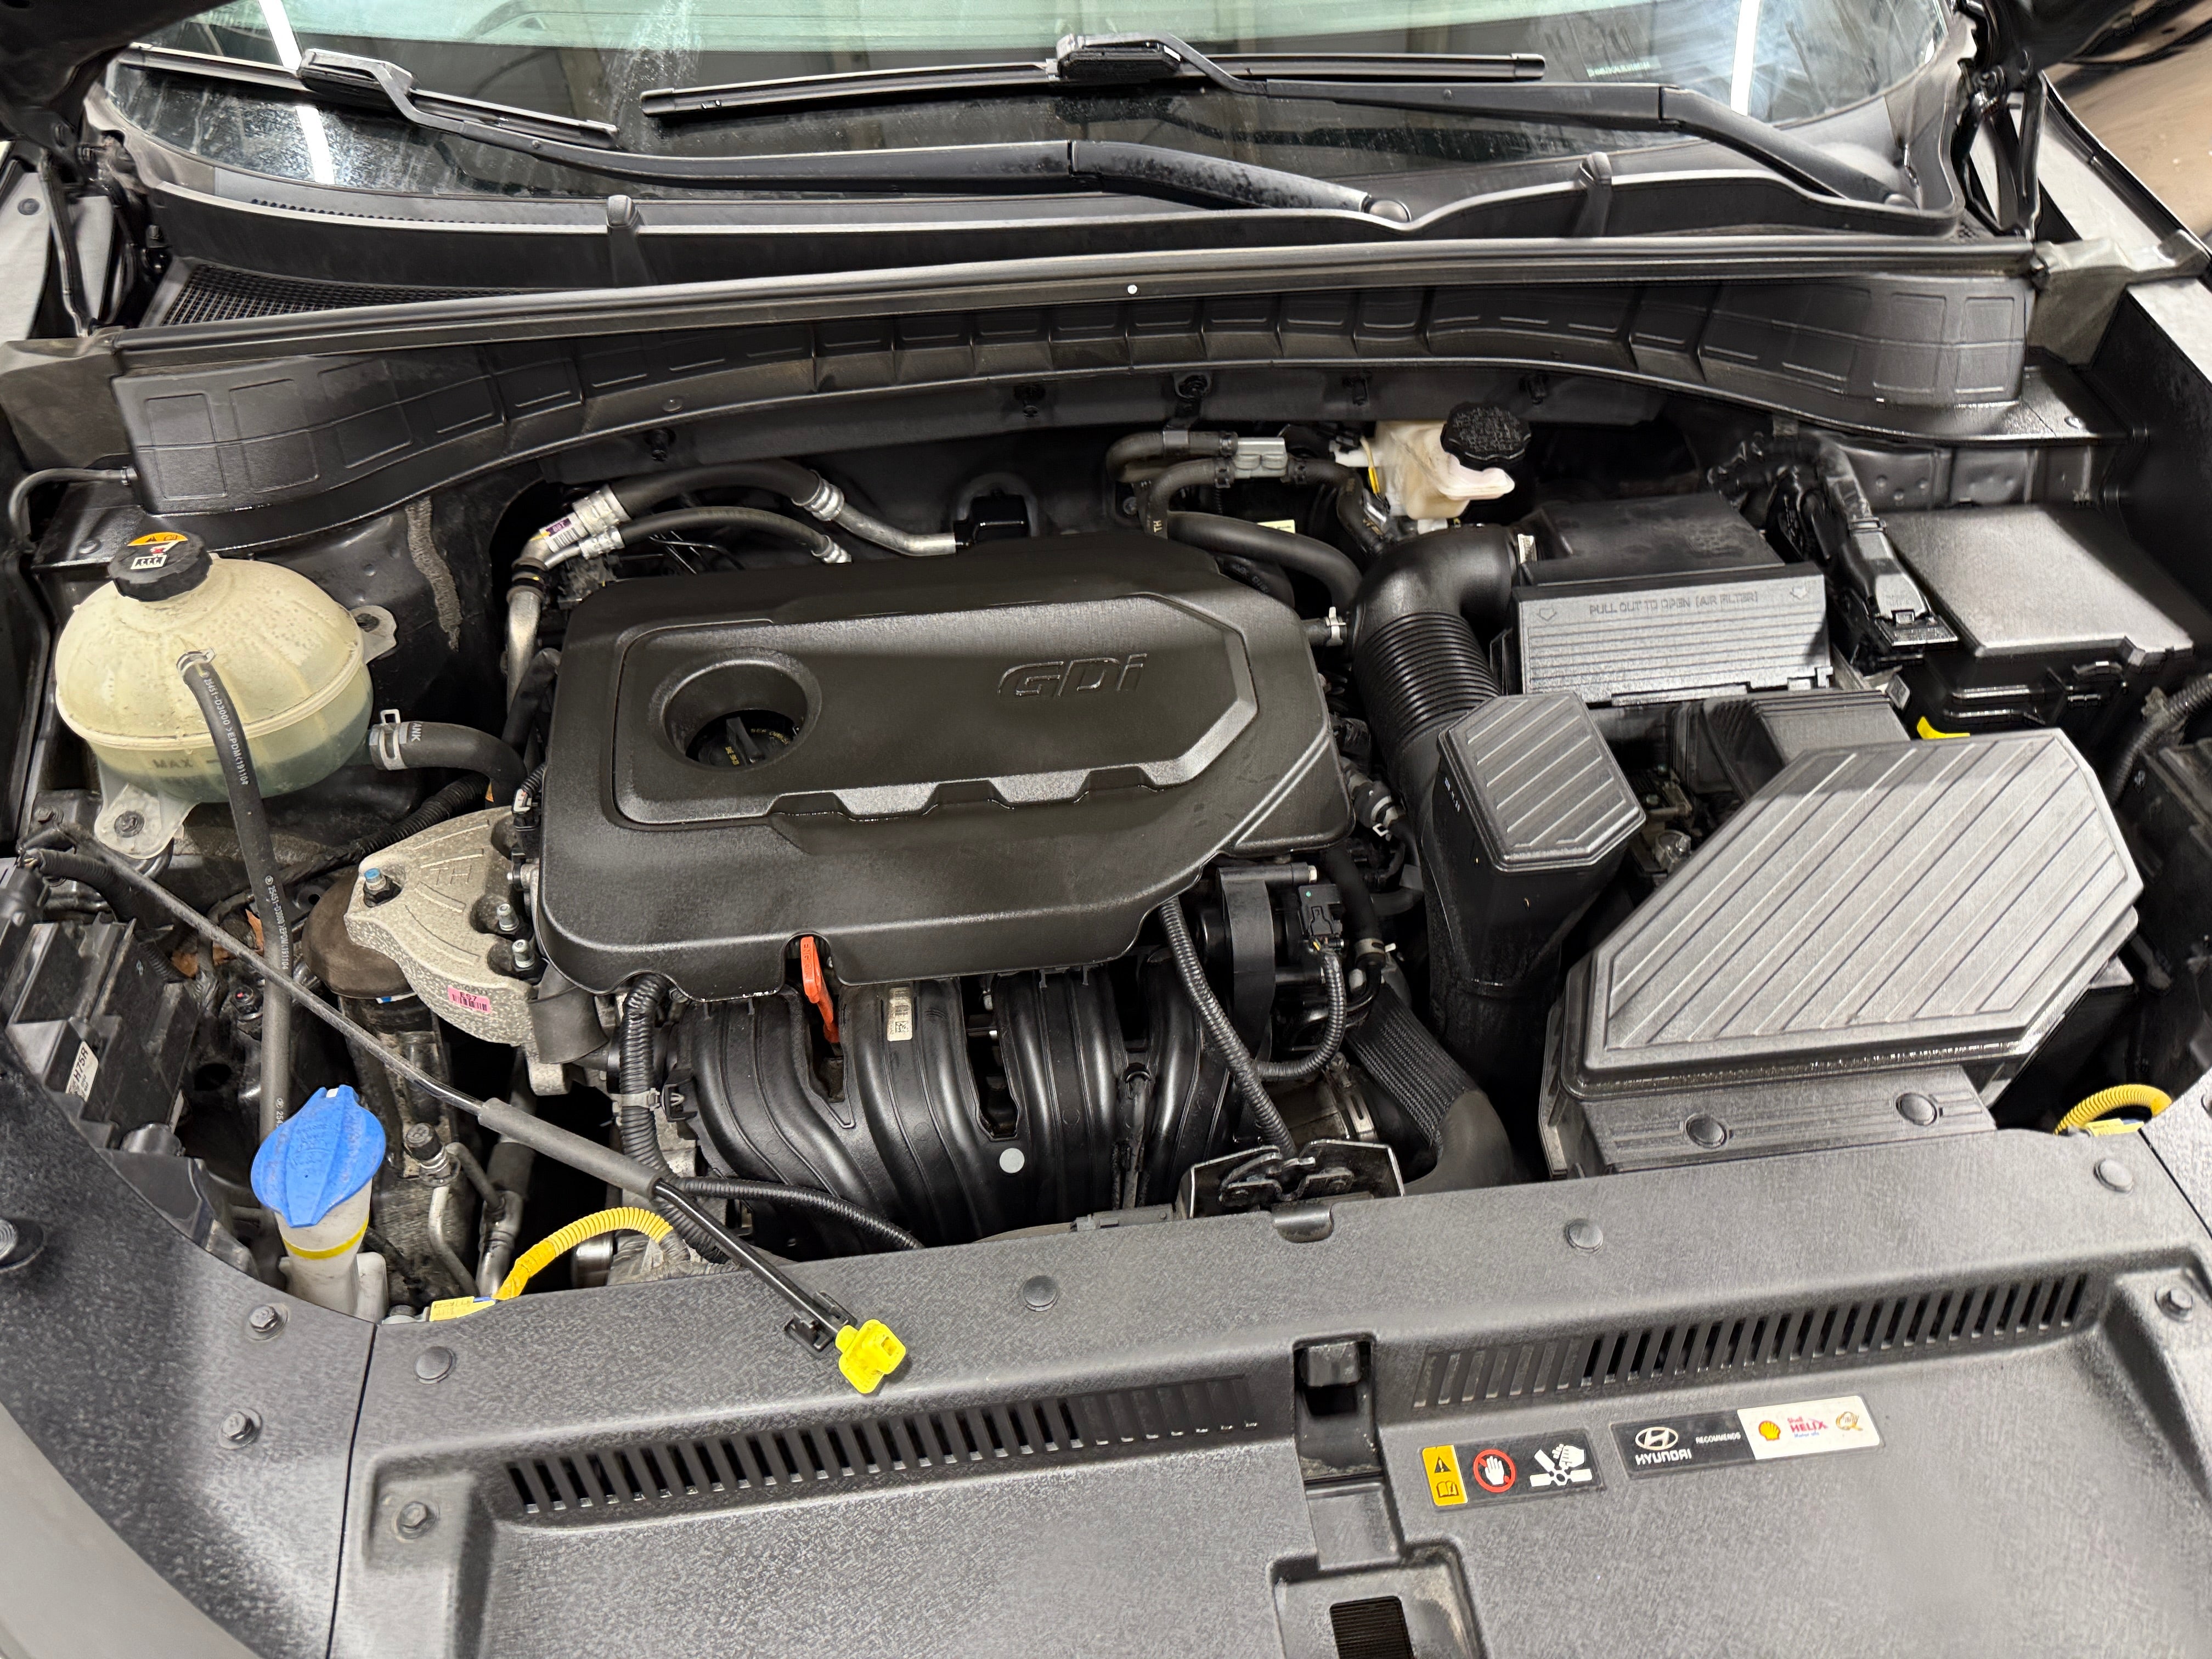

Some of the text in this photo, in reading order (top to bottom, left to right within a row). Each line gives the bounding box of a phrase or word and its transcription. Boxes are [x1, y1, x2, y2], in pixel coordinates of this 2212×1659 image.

[1589, 603, 1617, 615] PULL
[1620, 600, 1642, 612] OUT
[1644, 598, 1658, 611] TO
[1661, 596, 1691, 609] OPEN
[73, 1046, 88, 1083] H75R
[1635, 1448, 1692, 1466] HYUNDAI
